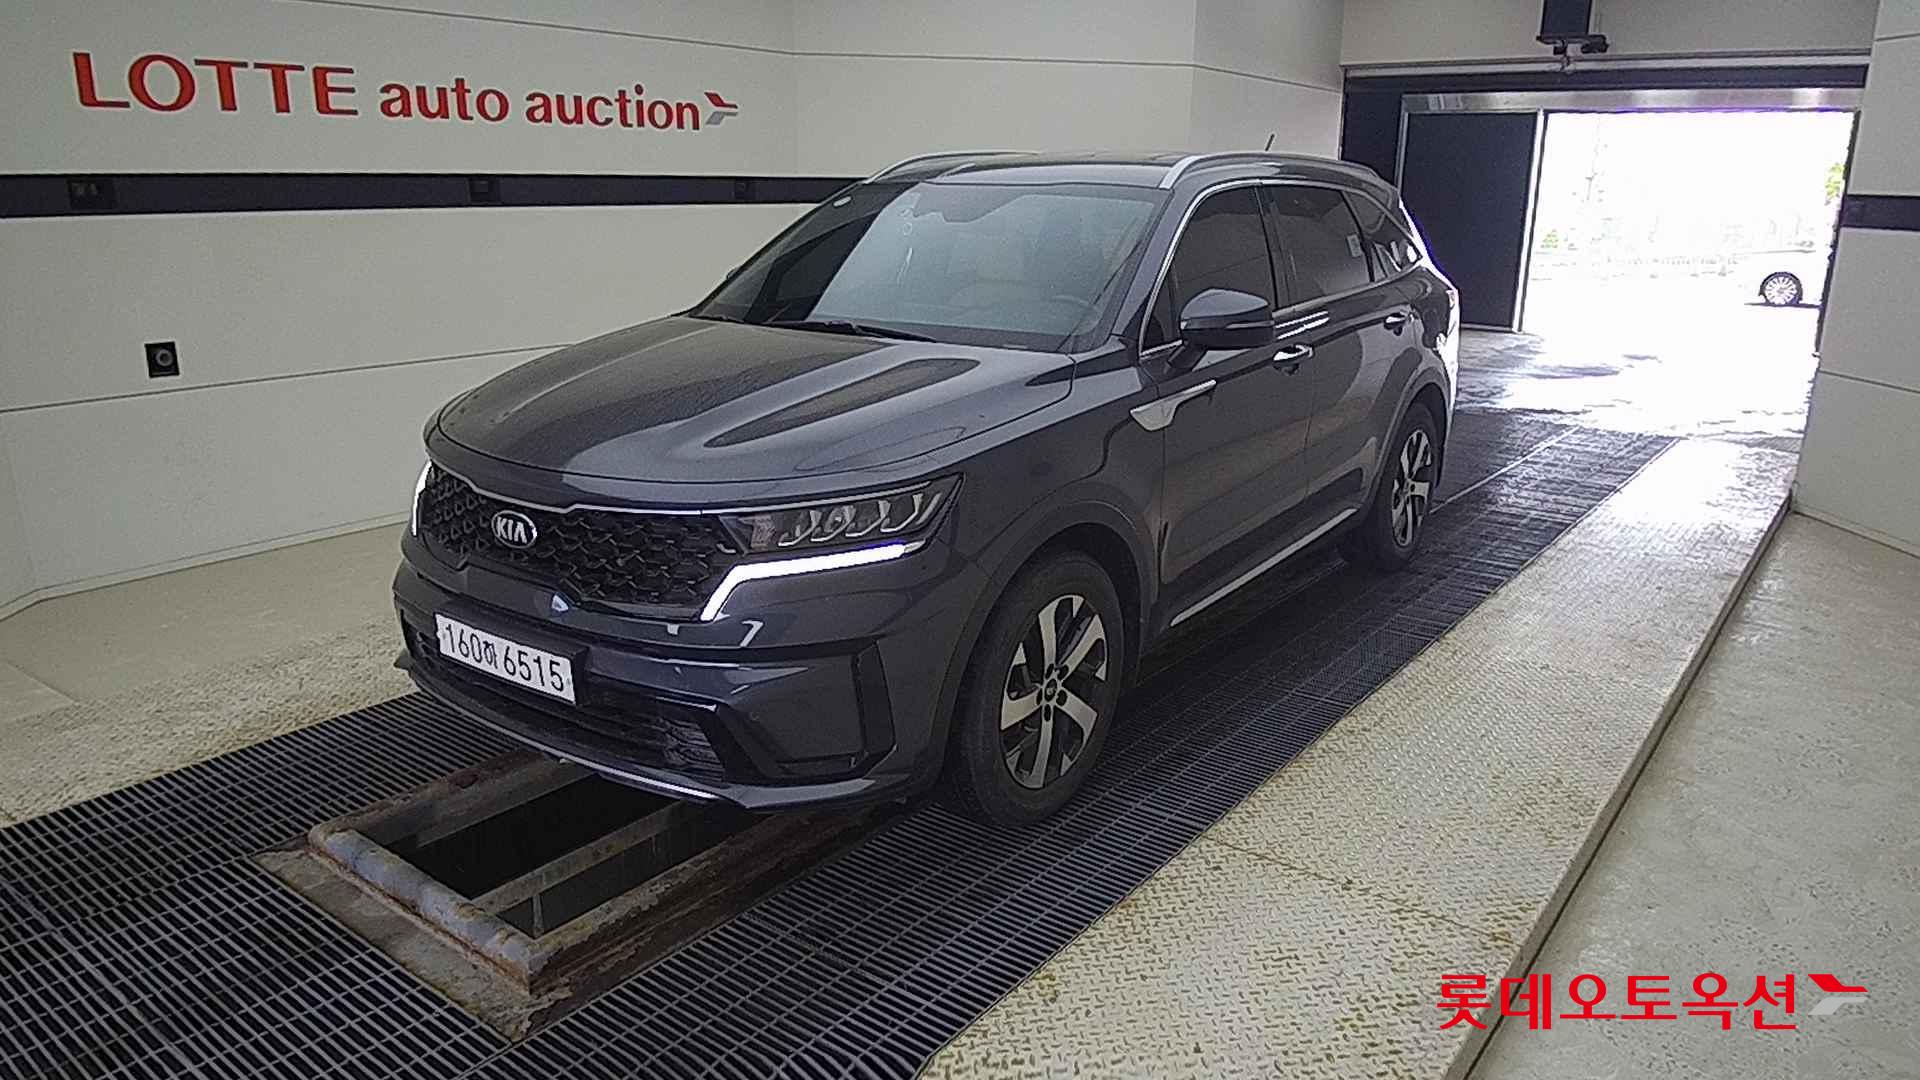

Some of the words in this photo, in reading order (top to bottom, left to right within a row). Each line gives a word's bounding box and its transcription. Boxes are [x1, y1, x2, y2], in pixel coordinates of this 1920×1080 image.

[73, 52, 359, 116] LOTTE
[379, 77, 510, 122] auto
[525, 83, 701, 131] auction
[496, 516, 528, 544] KIA
[503, 645, 564, 692] 6515
